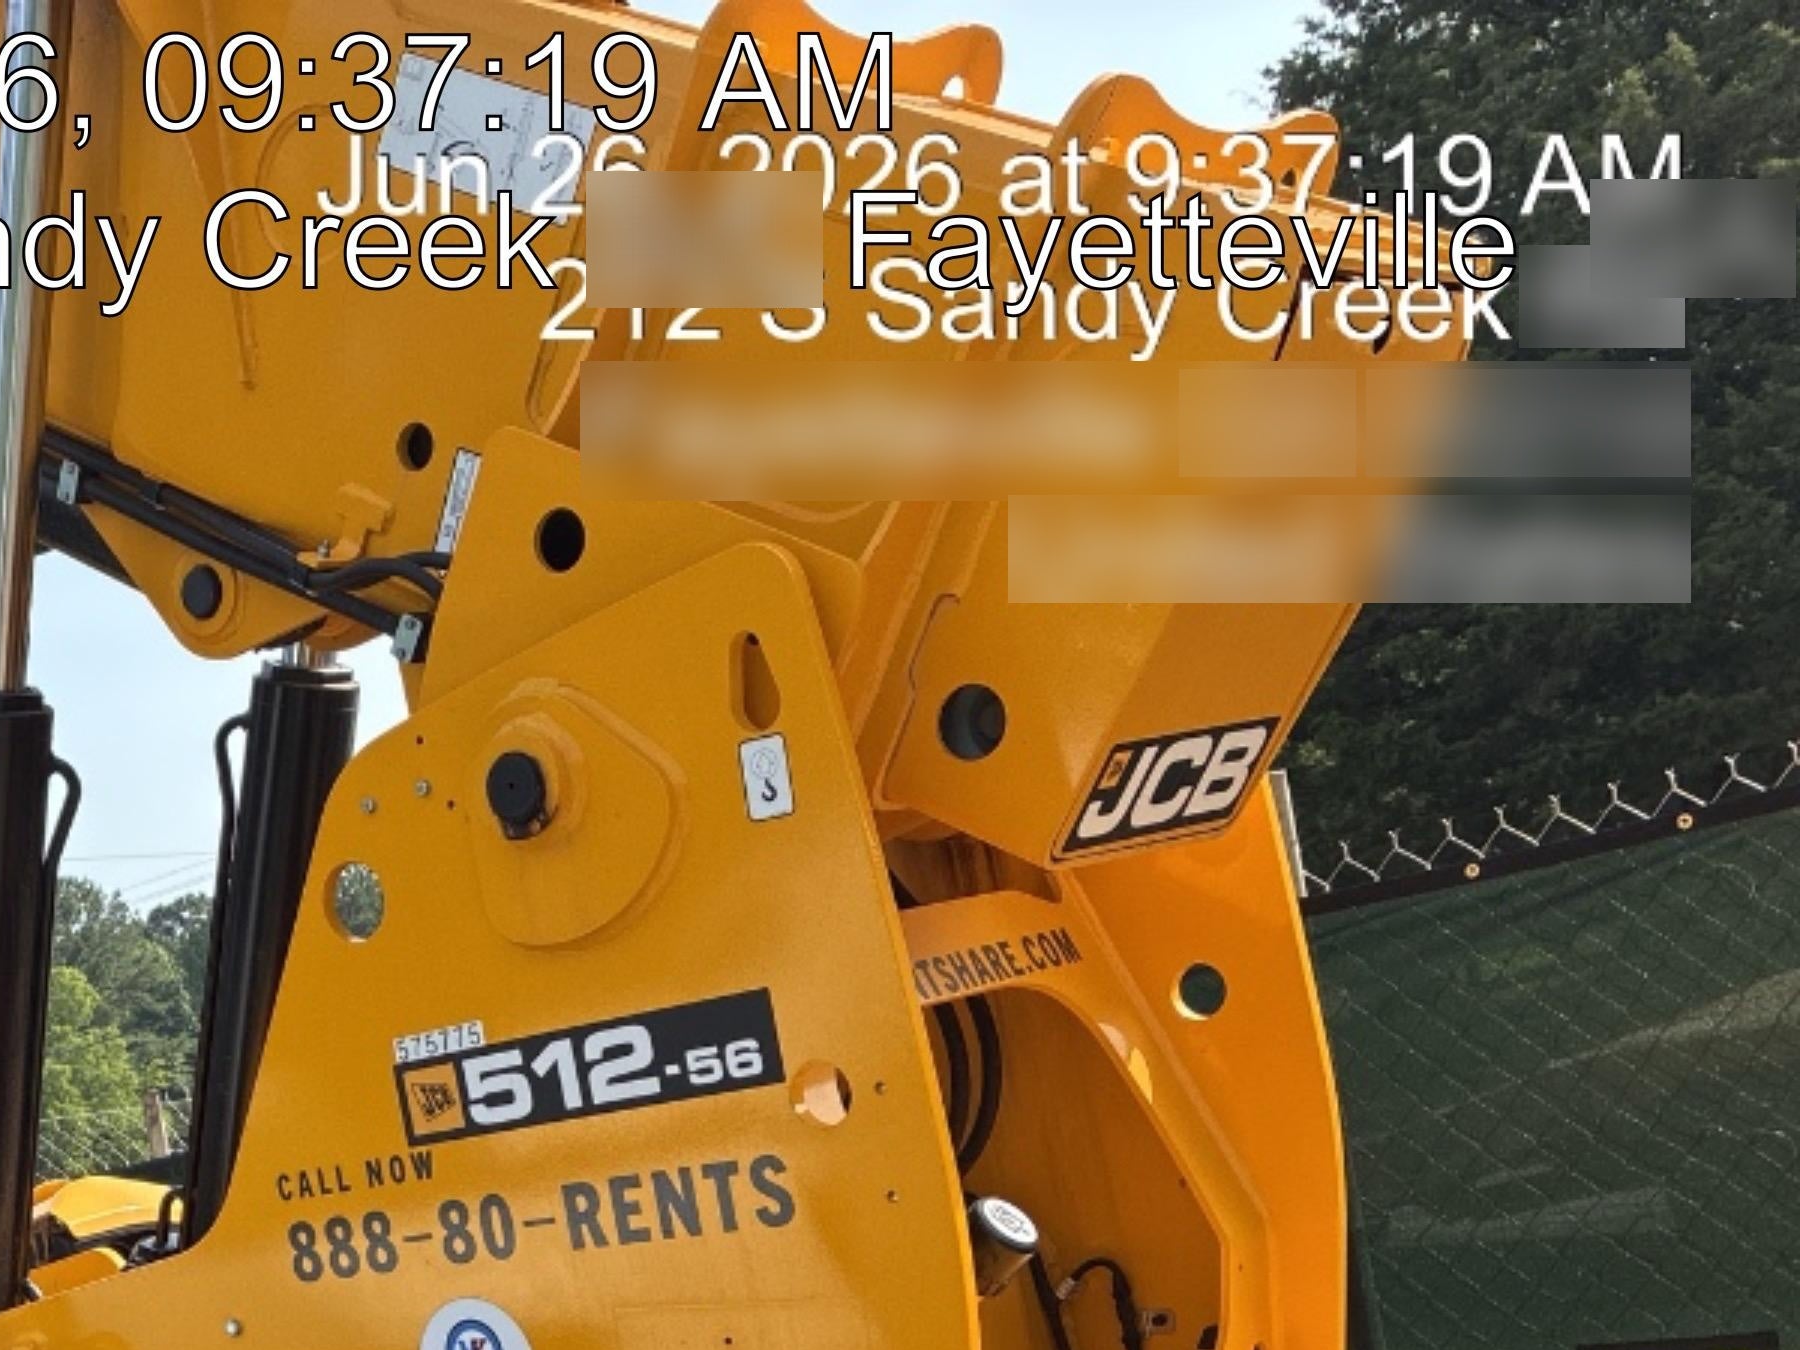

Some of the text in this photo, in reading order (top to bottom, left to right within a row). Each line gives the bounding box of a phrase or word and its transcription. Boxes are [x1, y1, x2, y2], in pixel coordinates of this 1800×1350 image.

[1076, 725, 1268, 839] JCB
[277, 1151, 434, 1201] CALL NOW
[288, 1154, 797, 1283] 888-80-RENTS
